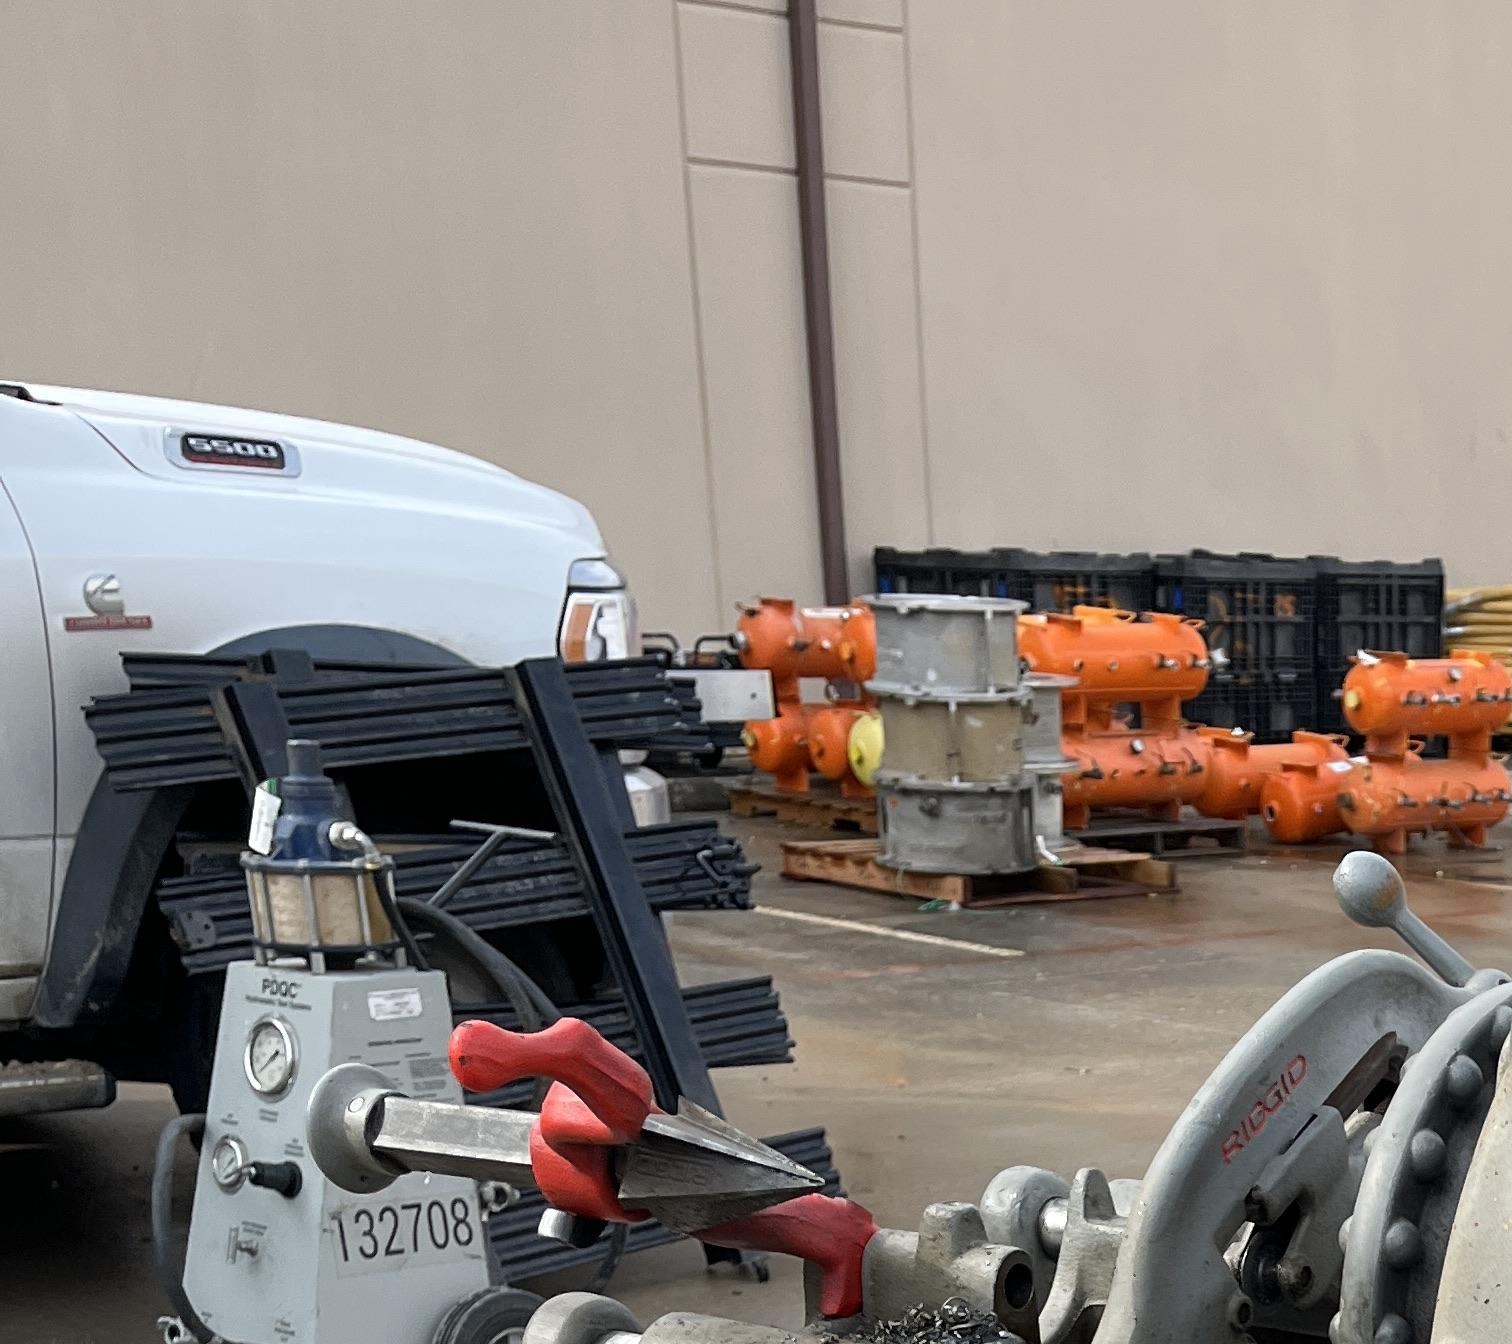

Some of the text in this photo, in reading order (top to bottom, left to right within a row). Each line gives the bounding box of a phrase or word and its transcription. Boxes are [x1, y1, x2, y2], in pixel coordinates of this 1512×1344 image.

[187, 437, 278, 459] 5500
[1221, 1054, 1309, 1166] RIDGID
[331, 1197, 473, 1262] 132708
